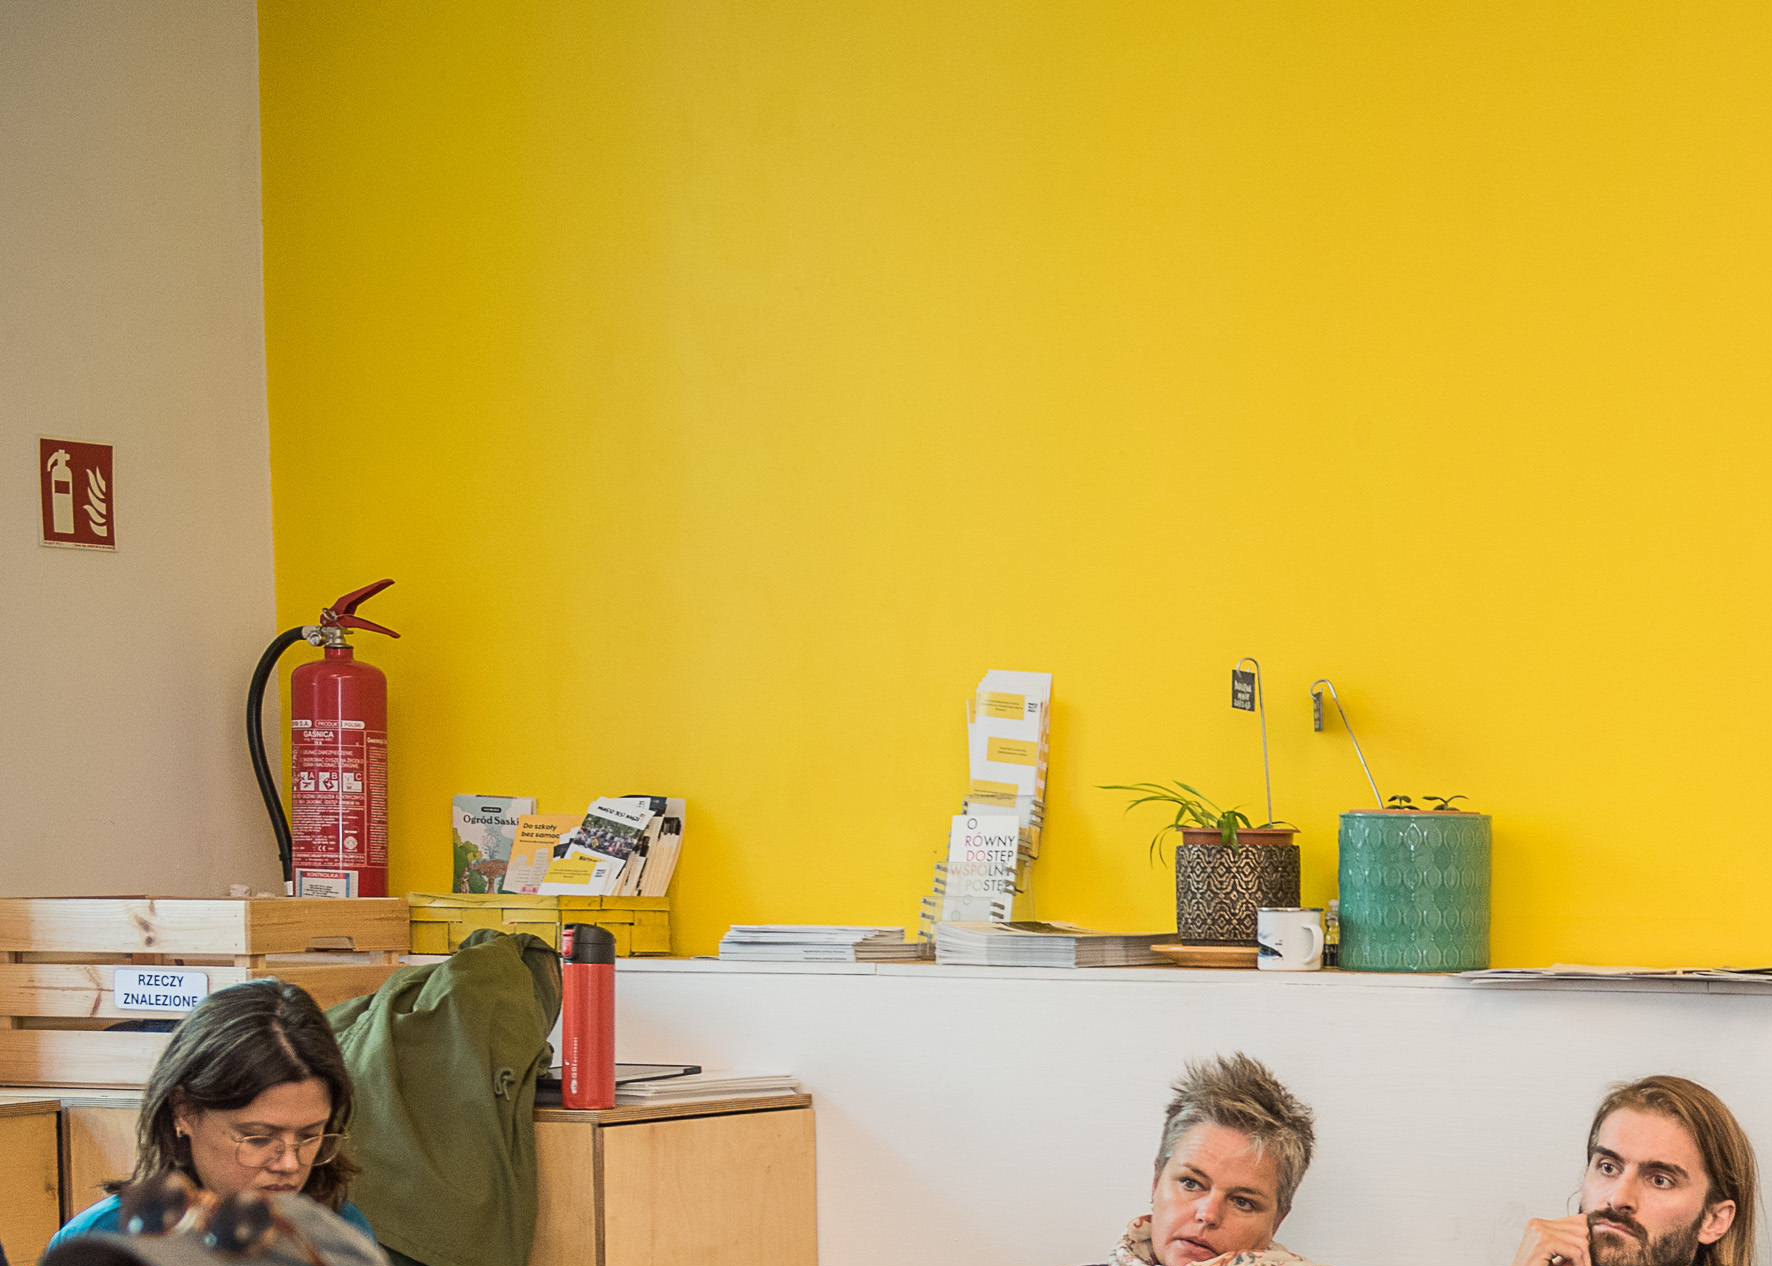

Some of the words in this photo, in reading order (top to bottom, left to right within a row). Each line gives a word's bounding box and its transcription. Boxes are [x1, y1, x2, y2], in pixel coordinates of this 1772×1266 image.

[303, 730, 334, 738] GAŚNICA
[463, 815, 493, 825] Ogród
[494, 816, 519, 826] Saski
[967, 818, 977, 830] O
[534, 823, 557, 831] szkoły
[965, 832, 1015, 847] RÓWNY
[138, 974, 184, 987] RZECZY
[123, 993, 198, 1007] ZNALEZIONE
